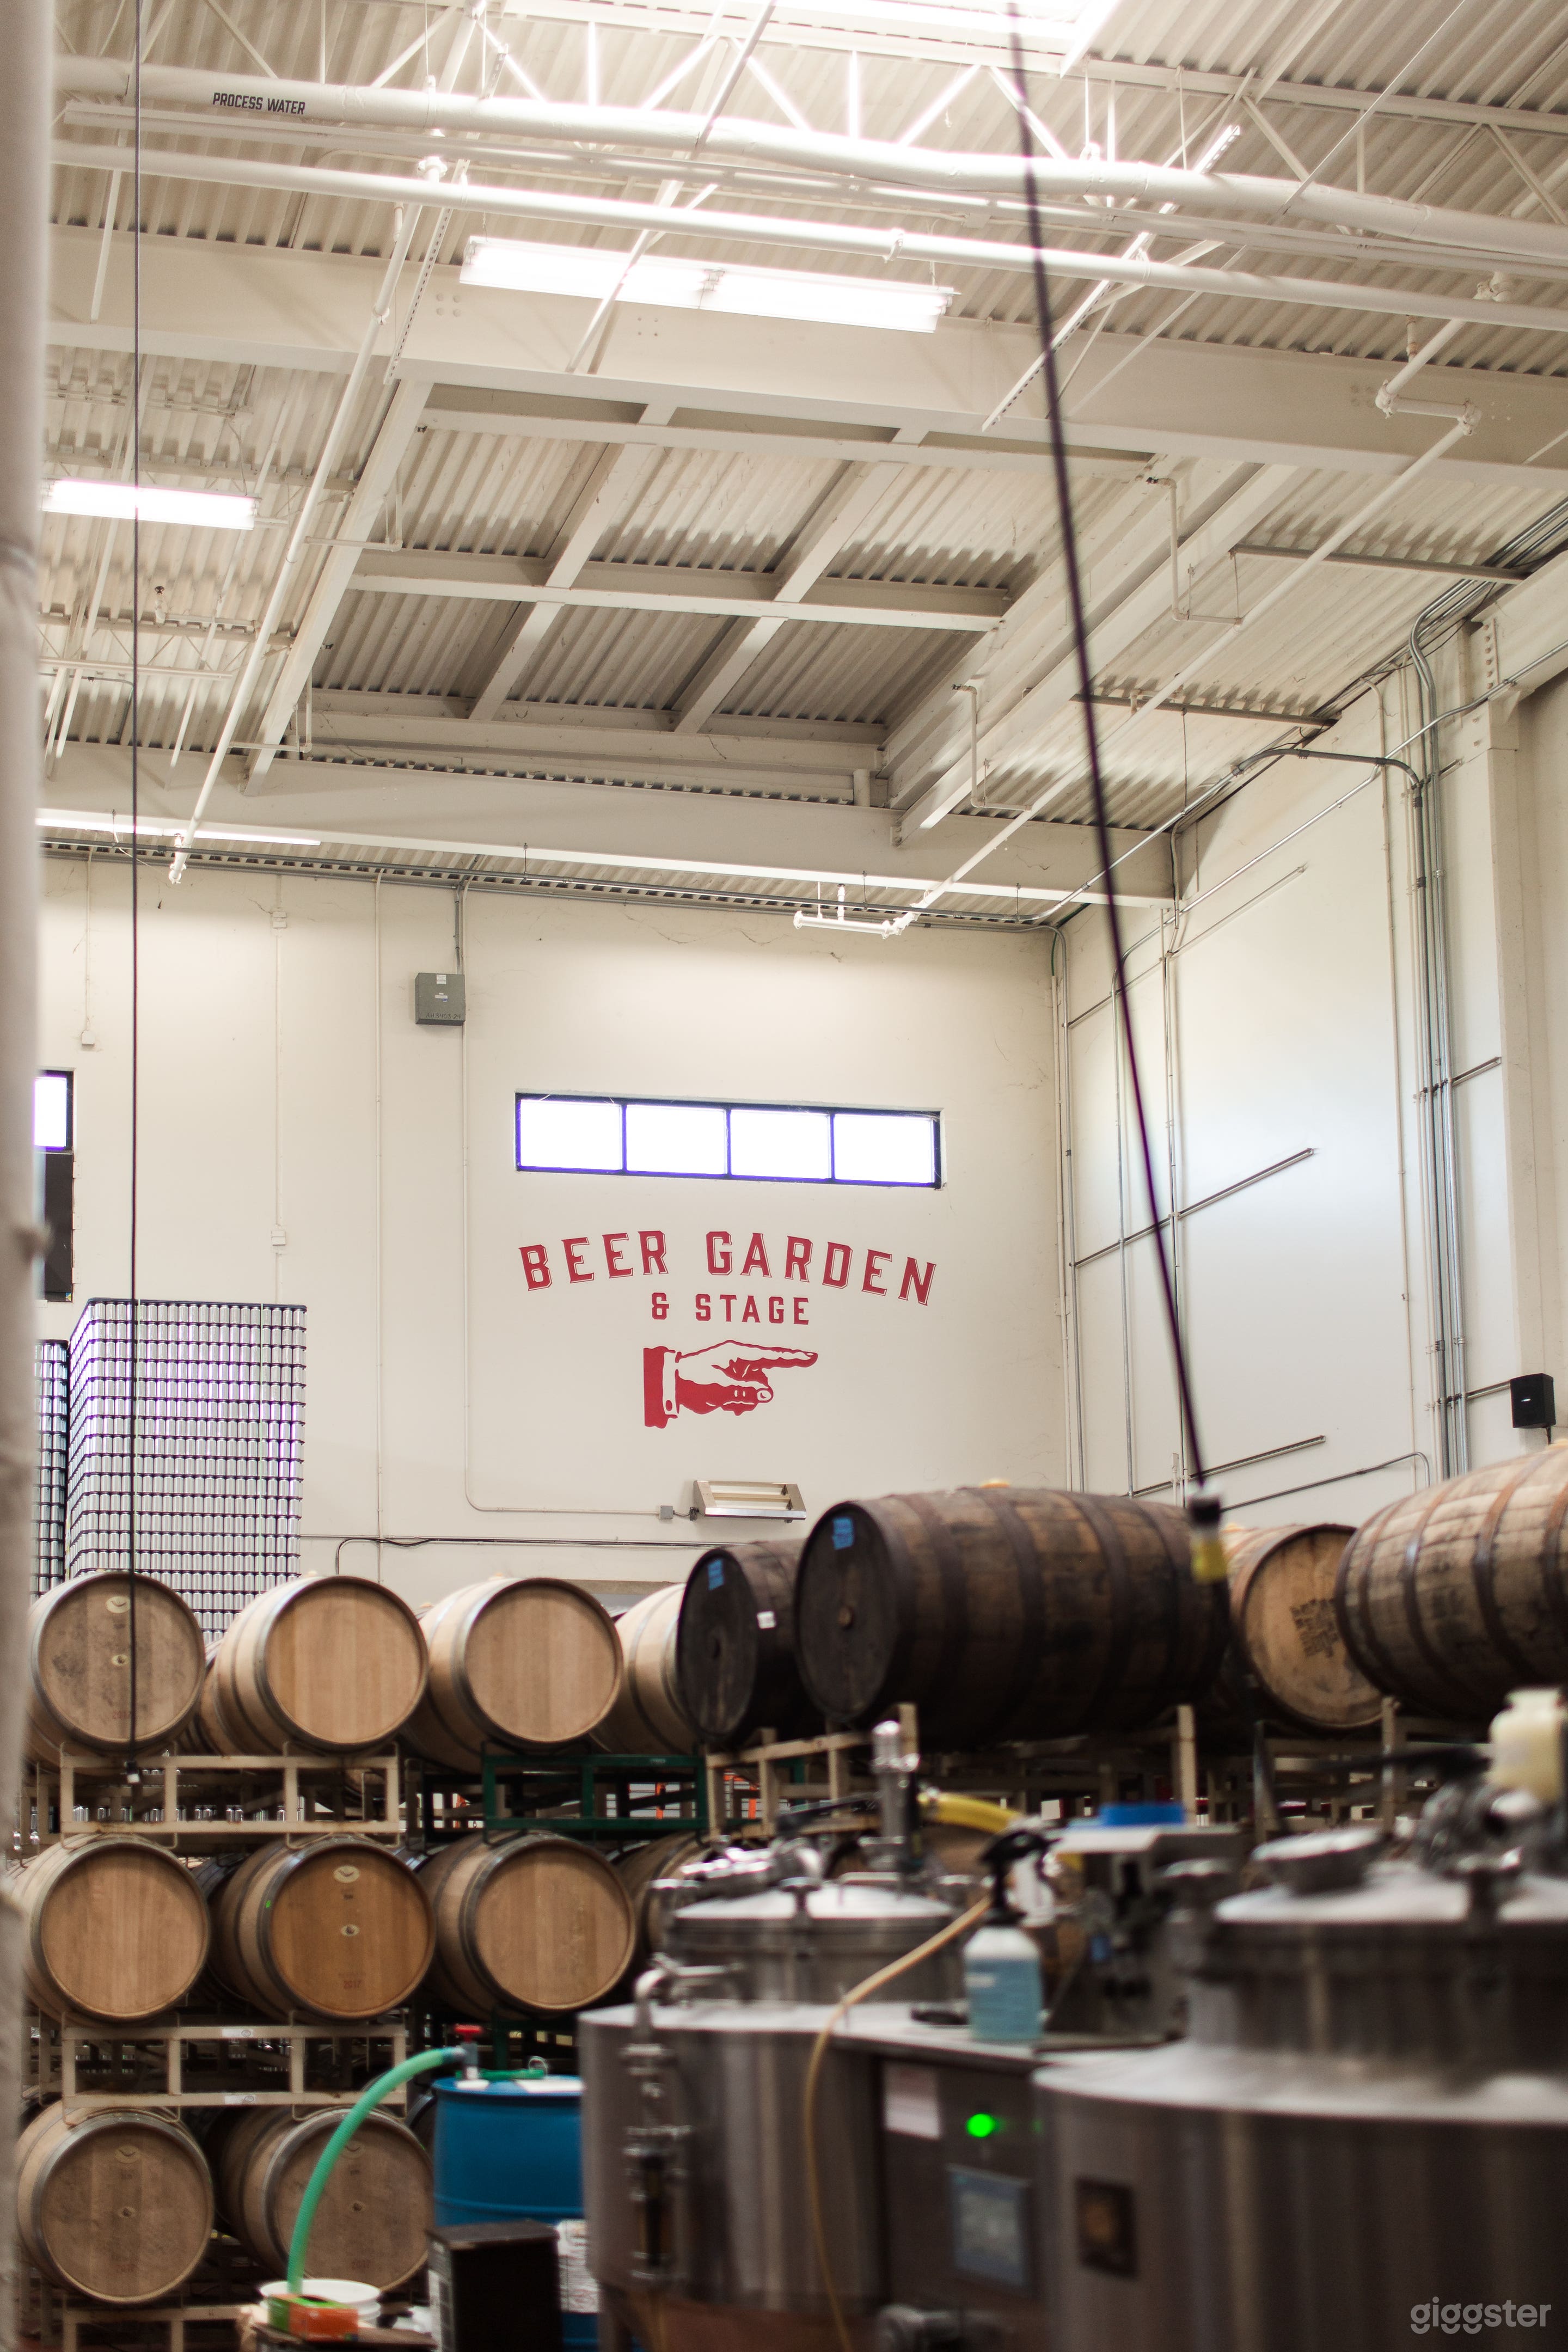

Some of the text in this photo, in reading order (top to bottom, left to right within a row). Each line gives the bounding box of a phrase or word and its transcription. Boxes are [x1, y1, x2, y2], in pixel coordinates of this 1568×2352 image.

[212, 93, 305, 115] PROCESS WATER
[518, 1230, 937, 1306] BEER GARDEN
[652, 1292, 810, 1325] & STAGE
